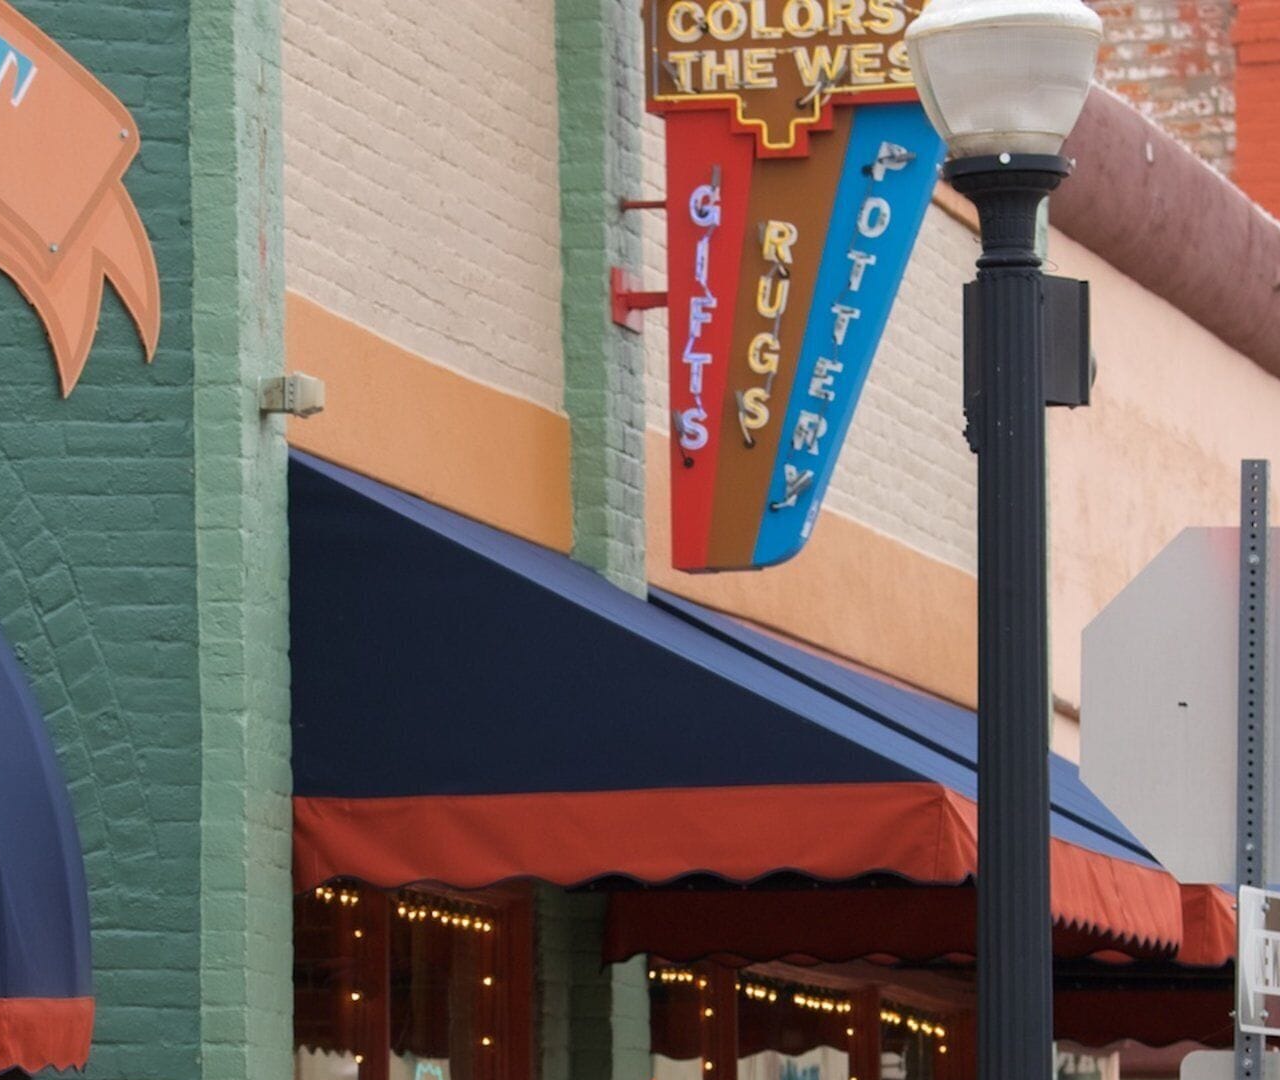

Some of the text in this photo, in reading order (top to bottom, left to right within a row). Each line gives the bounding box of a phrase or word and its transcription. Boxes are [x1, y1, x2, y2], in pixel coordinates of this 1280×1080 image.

[667, 0, 907, 43] COLORS
[667, 42, 913, 92] THE WES
[682, 184, 722, 450] GIFTS
[744, 220, 798, 430] RUGS
[782, 141, 908, 508] POTTERY
